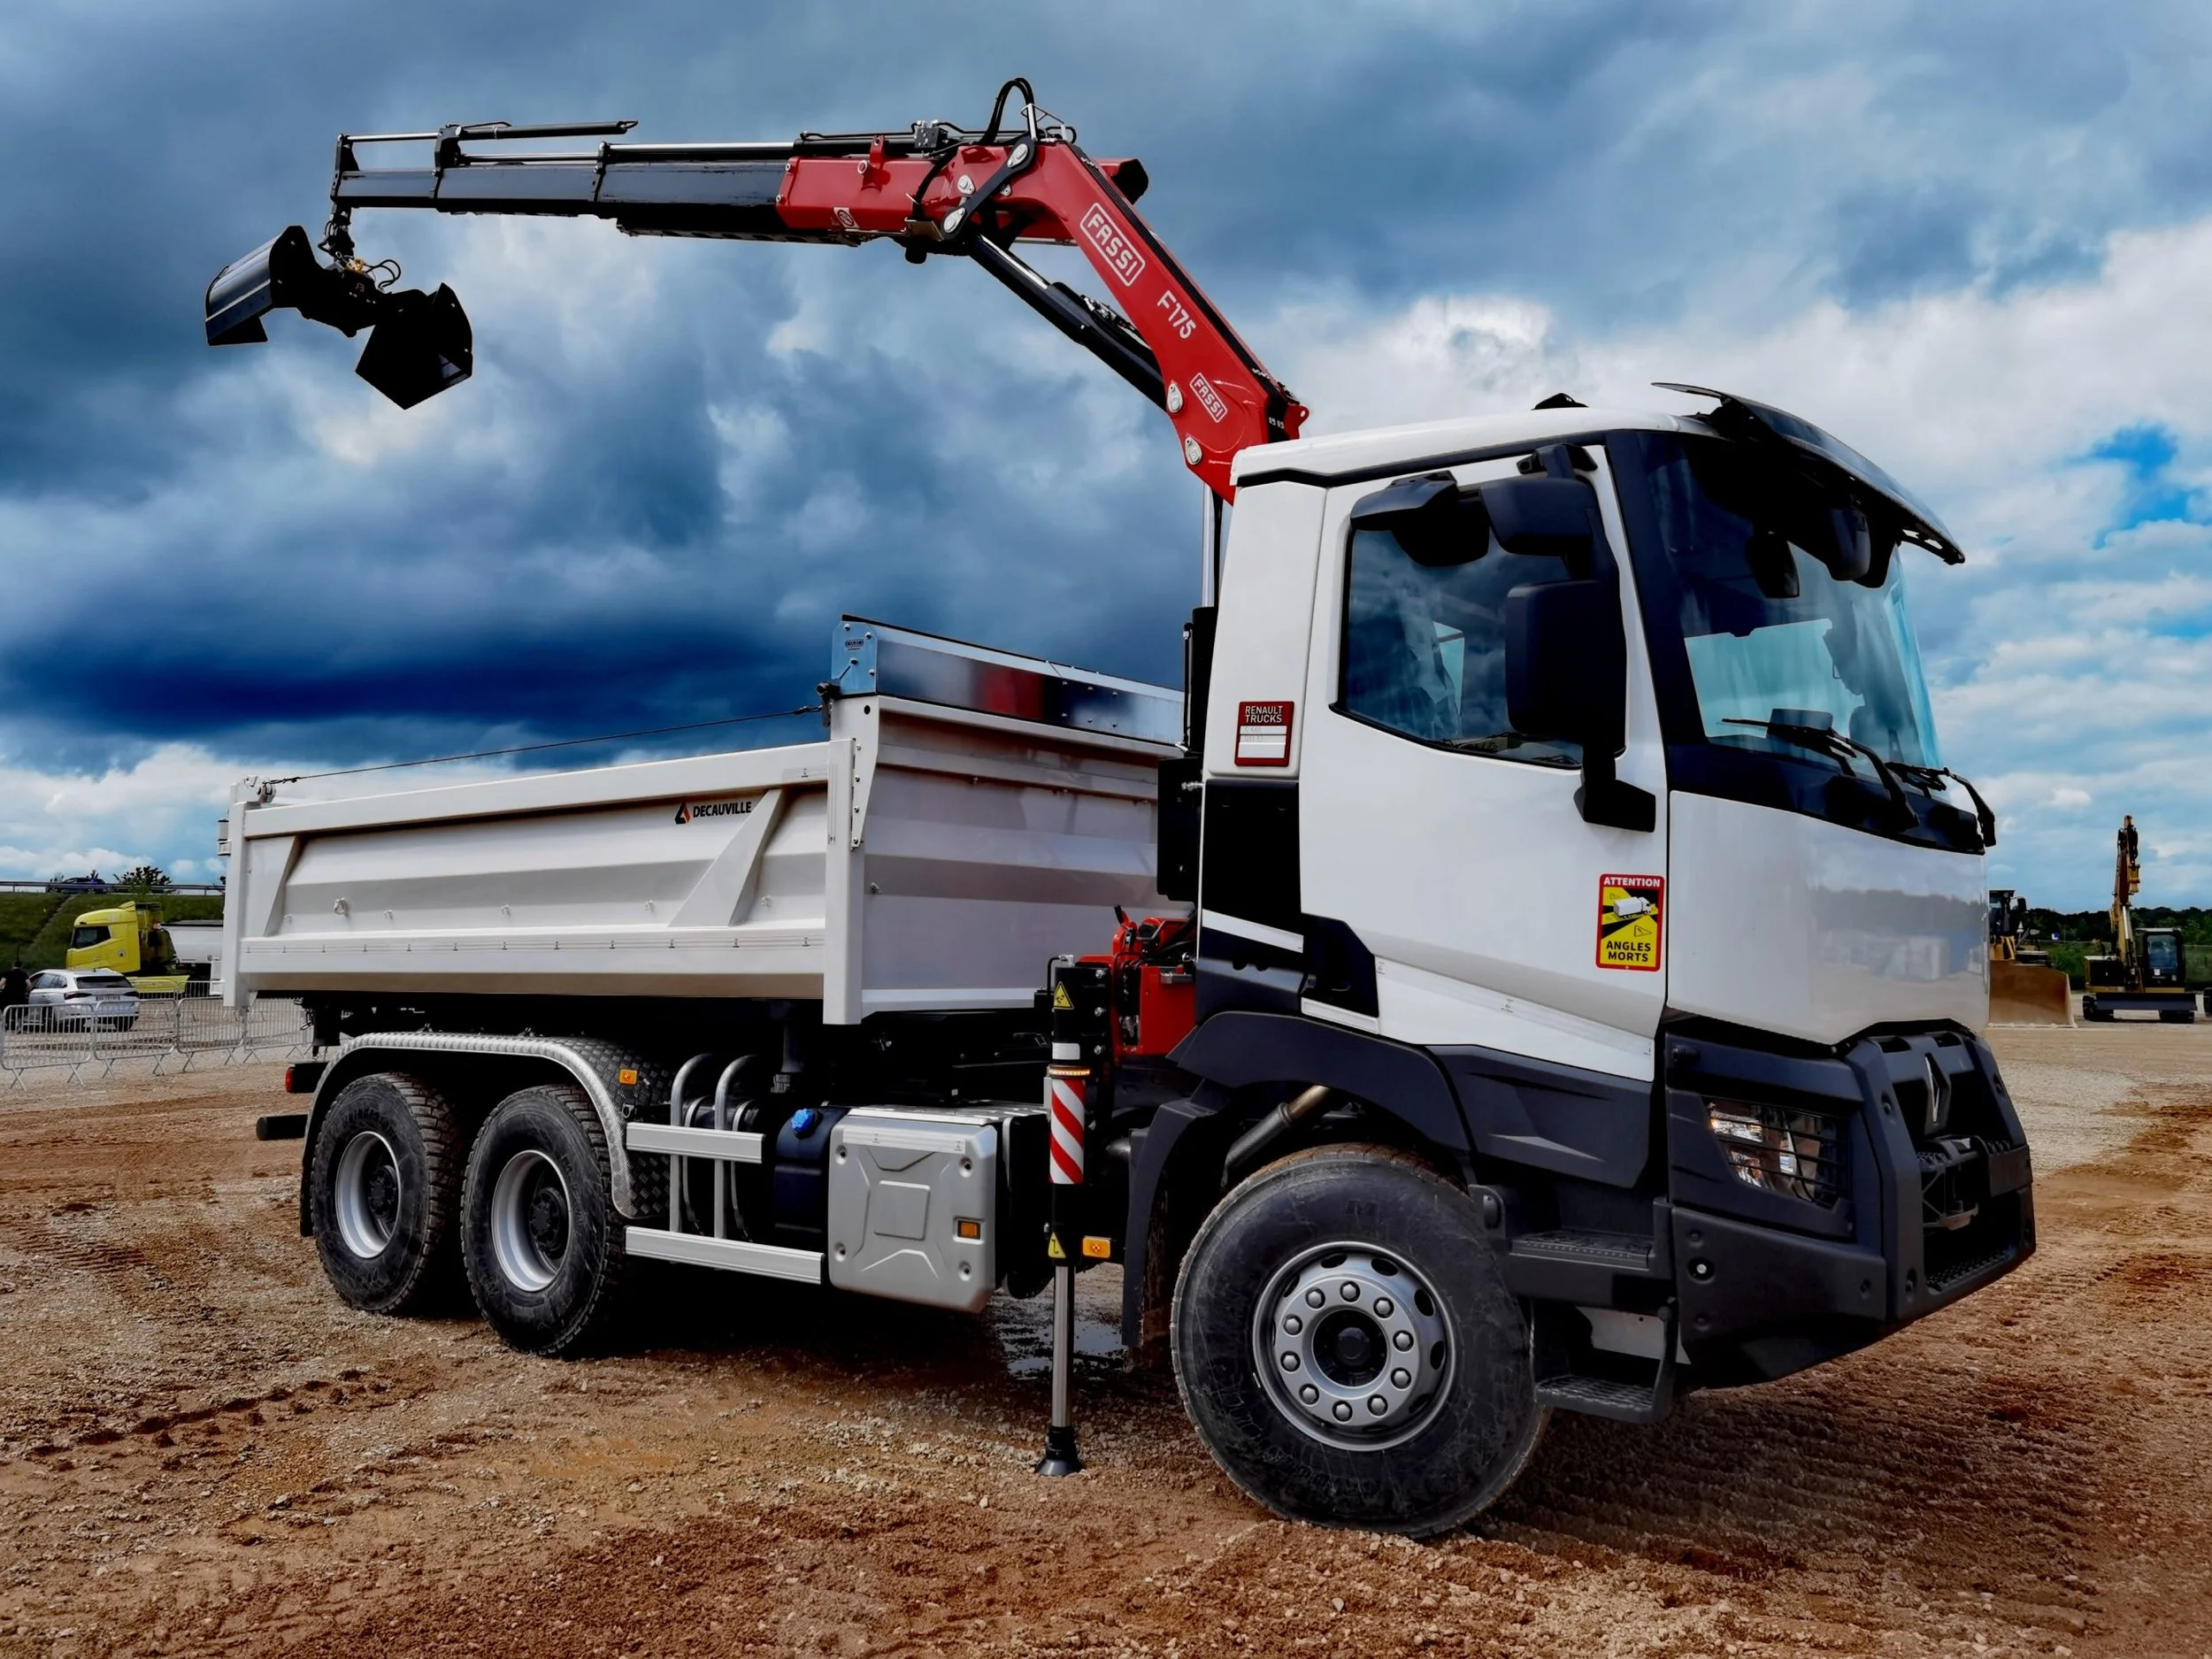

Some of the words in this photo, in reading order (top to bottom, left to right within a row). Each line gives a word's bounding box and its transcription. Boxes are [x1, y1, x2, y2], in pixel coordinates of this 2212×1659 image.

[1087, 212, 1138, 276] FASSI
[1156, 289, 1197, 339] F175
[1194, 378, 1224, 418] FASSI
[1245, 705, 1284, 715] RENAULT
[1245, 714, 1283, 724] TRUCKS
[693, 801, 752, 818] DECAUVILLE
[1603, 876, 1661, 887] ATTENTION
[1606, 941, 1652, 952] ANGLES
[1608, 951, 1649, 963] MORTS
